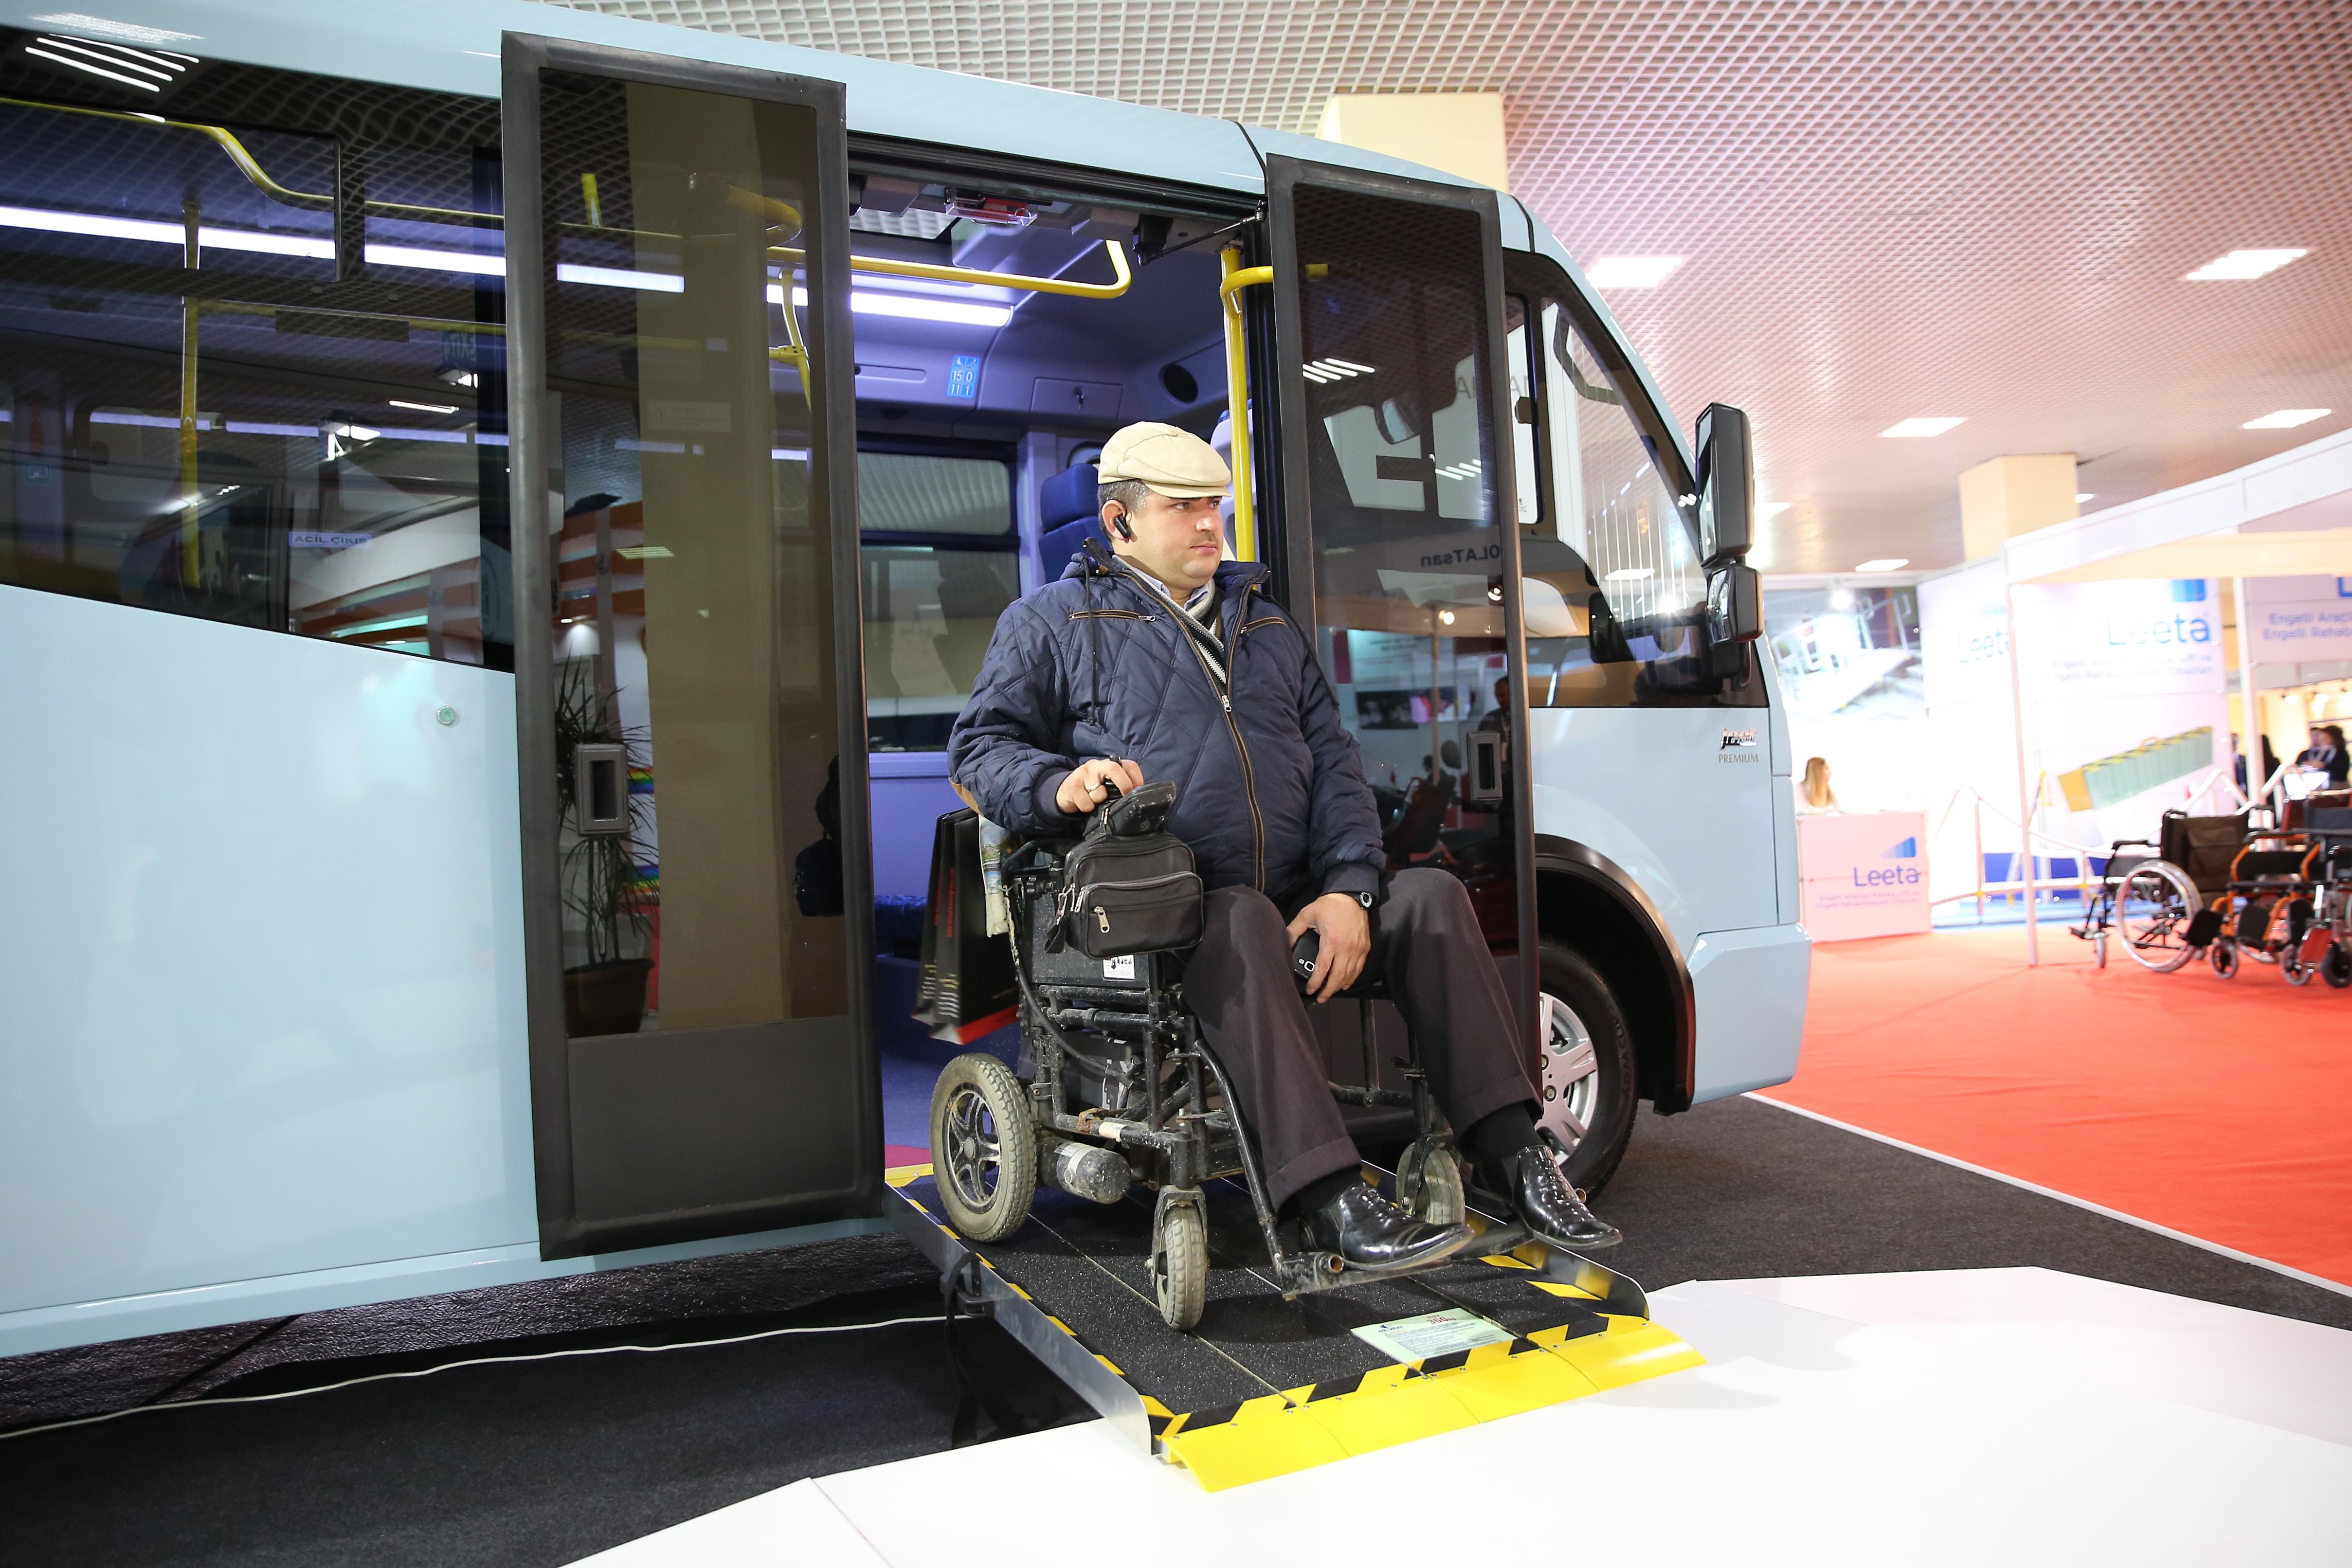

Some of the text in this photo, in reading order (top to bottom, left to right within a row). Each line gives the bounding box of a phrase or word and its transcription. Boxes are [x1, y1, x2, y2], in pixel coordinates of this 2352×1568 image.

[953, 370, 973, 382] 15 0
[951, 384, 970, 396] 11 1
[2107, 613, 2211, 646] Leeta
[1719, 754, 1759, 763] PREMIUM
[1854, 866, 1918, 887] Leeta
